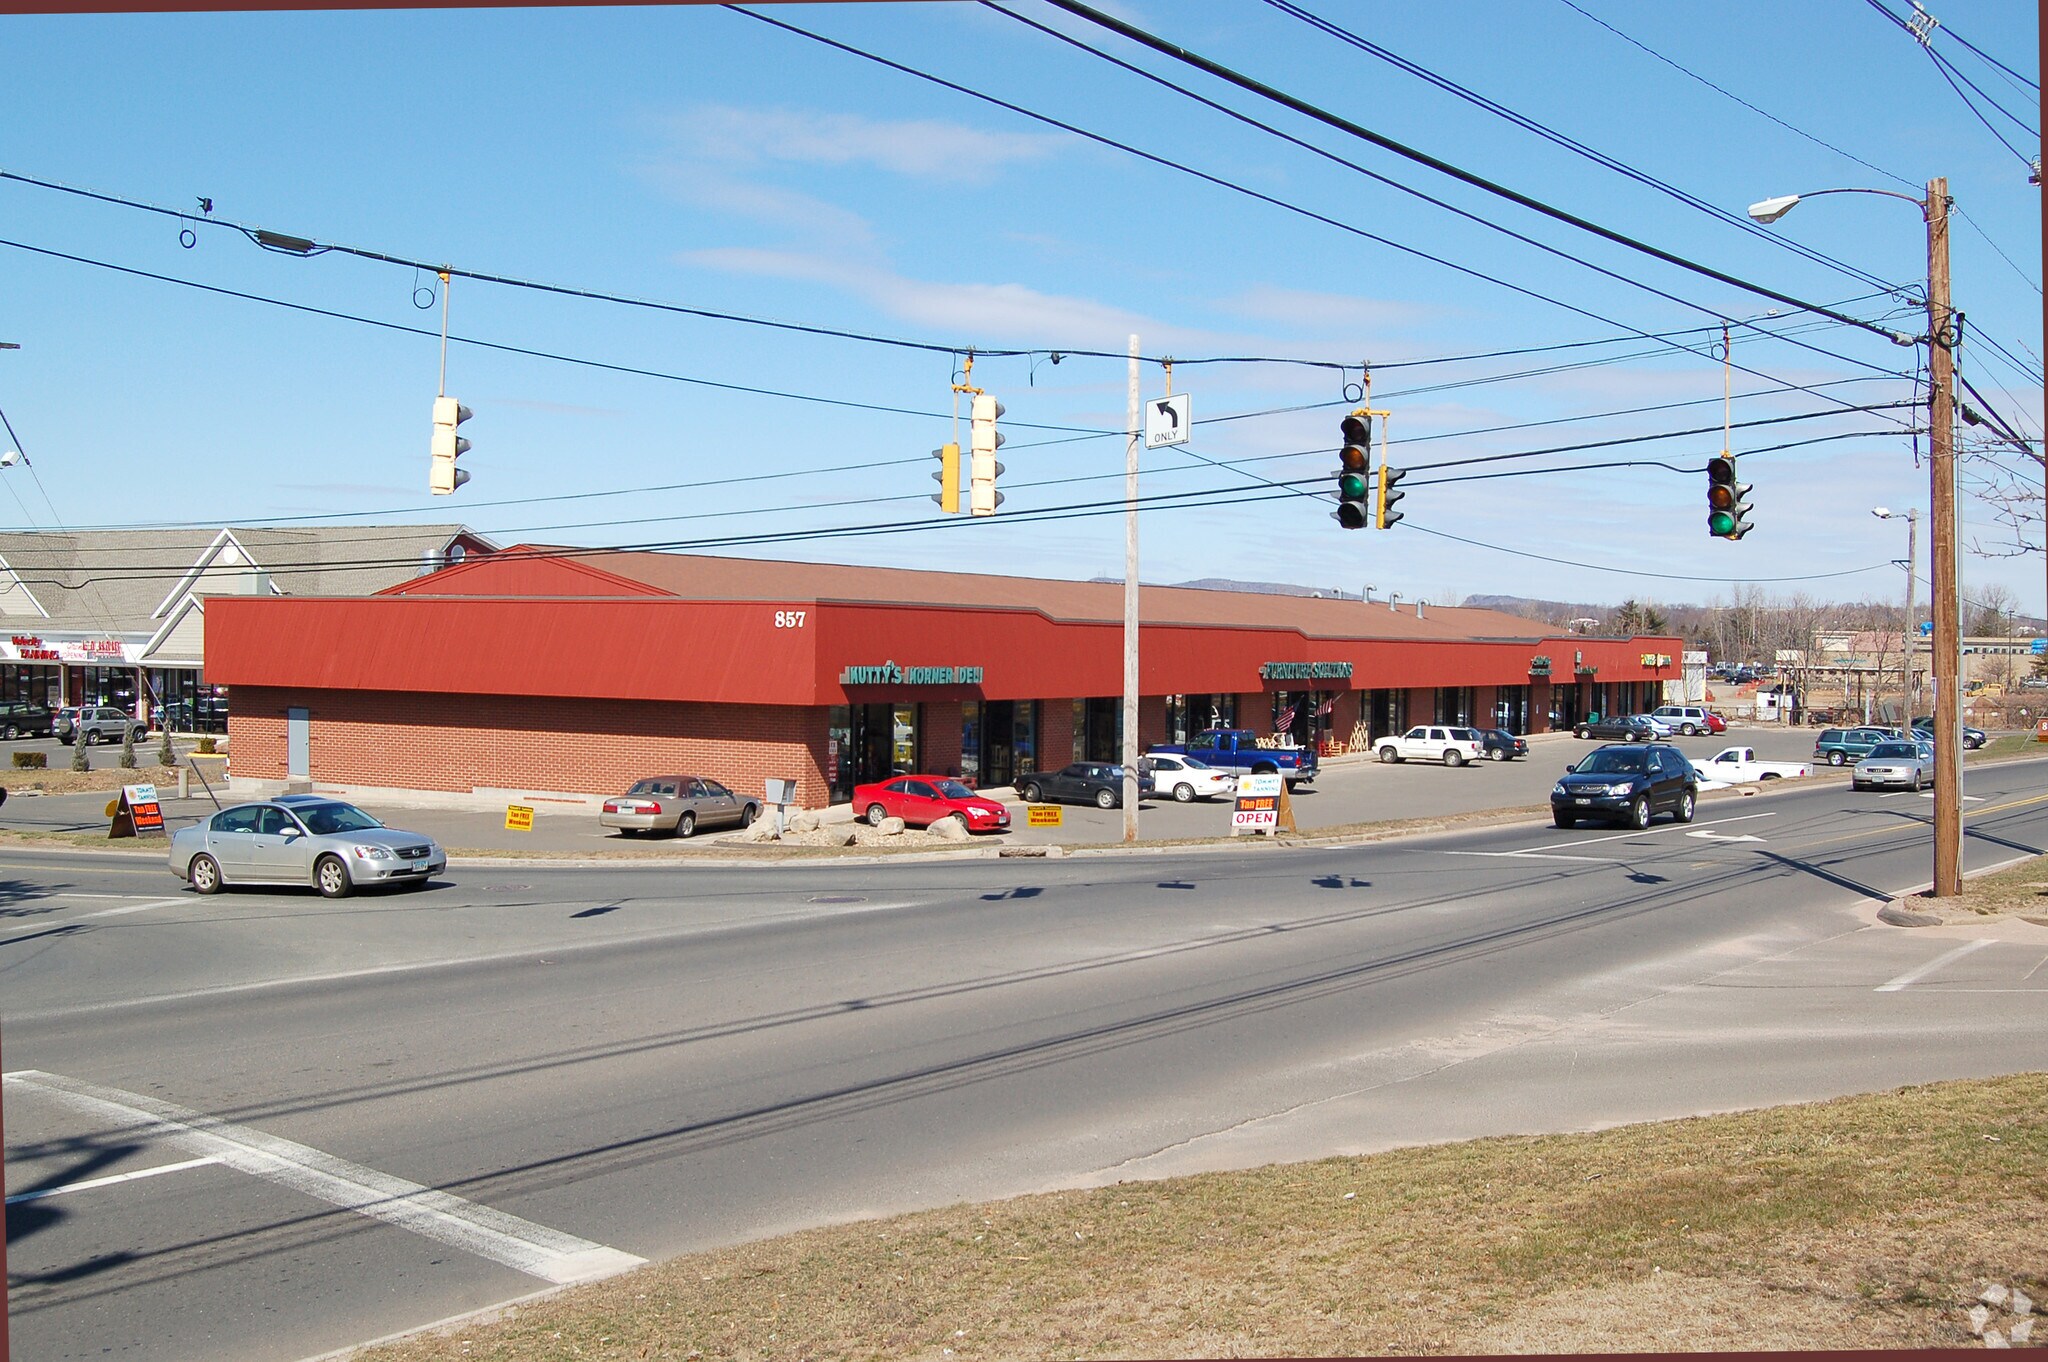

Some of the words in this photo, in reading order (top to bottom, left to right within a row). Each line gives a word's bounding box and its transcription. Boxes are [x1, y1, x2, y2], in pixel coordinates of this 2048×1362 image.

[1154, 430, 1178, 443] ONLY
[774, 610, 806, 628] 857
[1259, 662, 1311, 679] FURNITURE
[1240, 799, 1255, 809] Tan
[1255, 798, 1274, 810] FREE
[1236, 813, 1273, 823] OPEN
